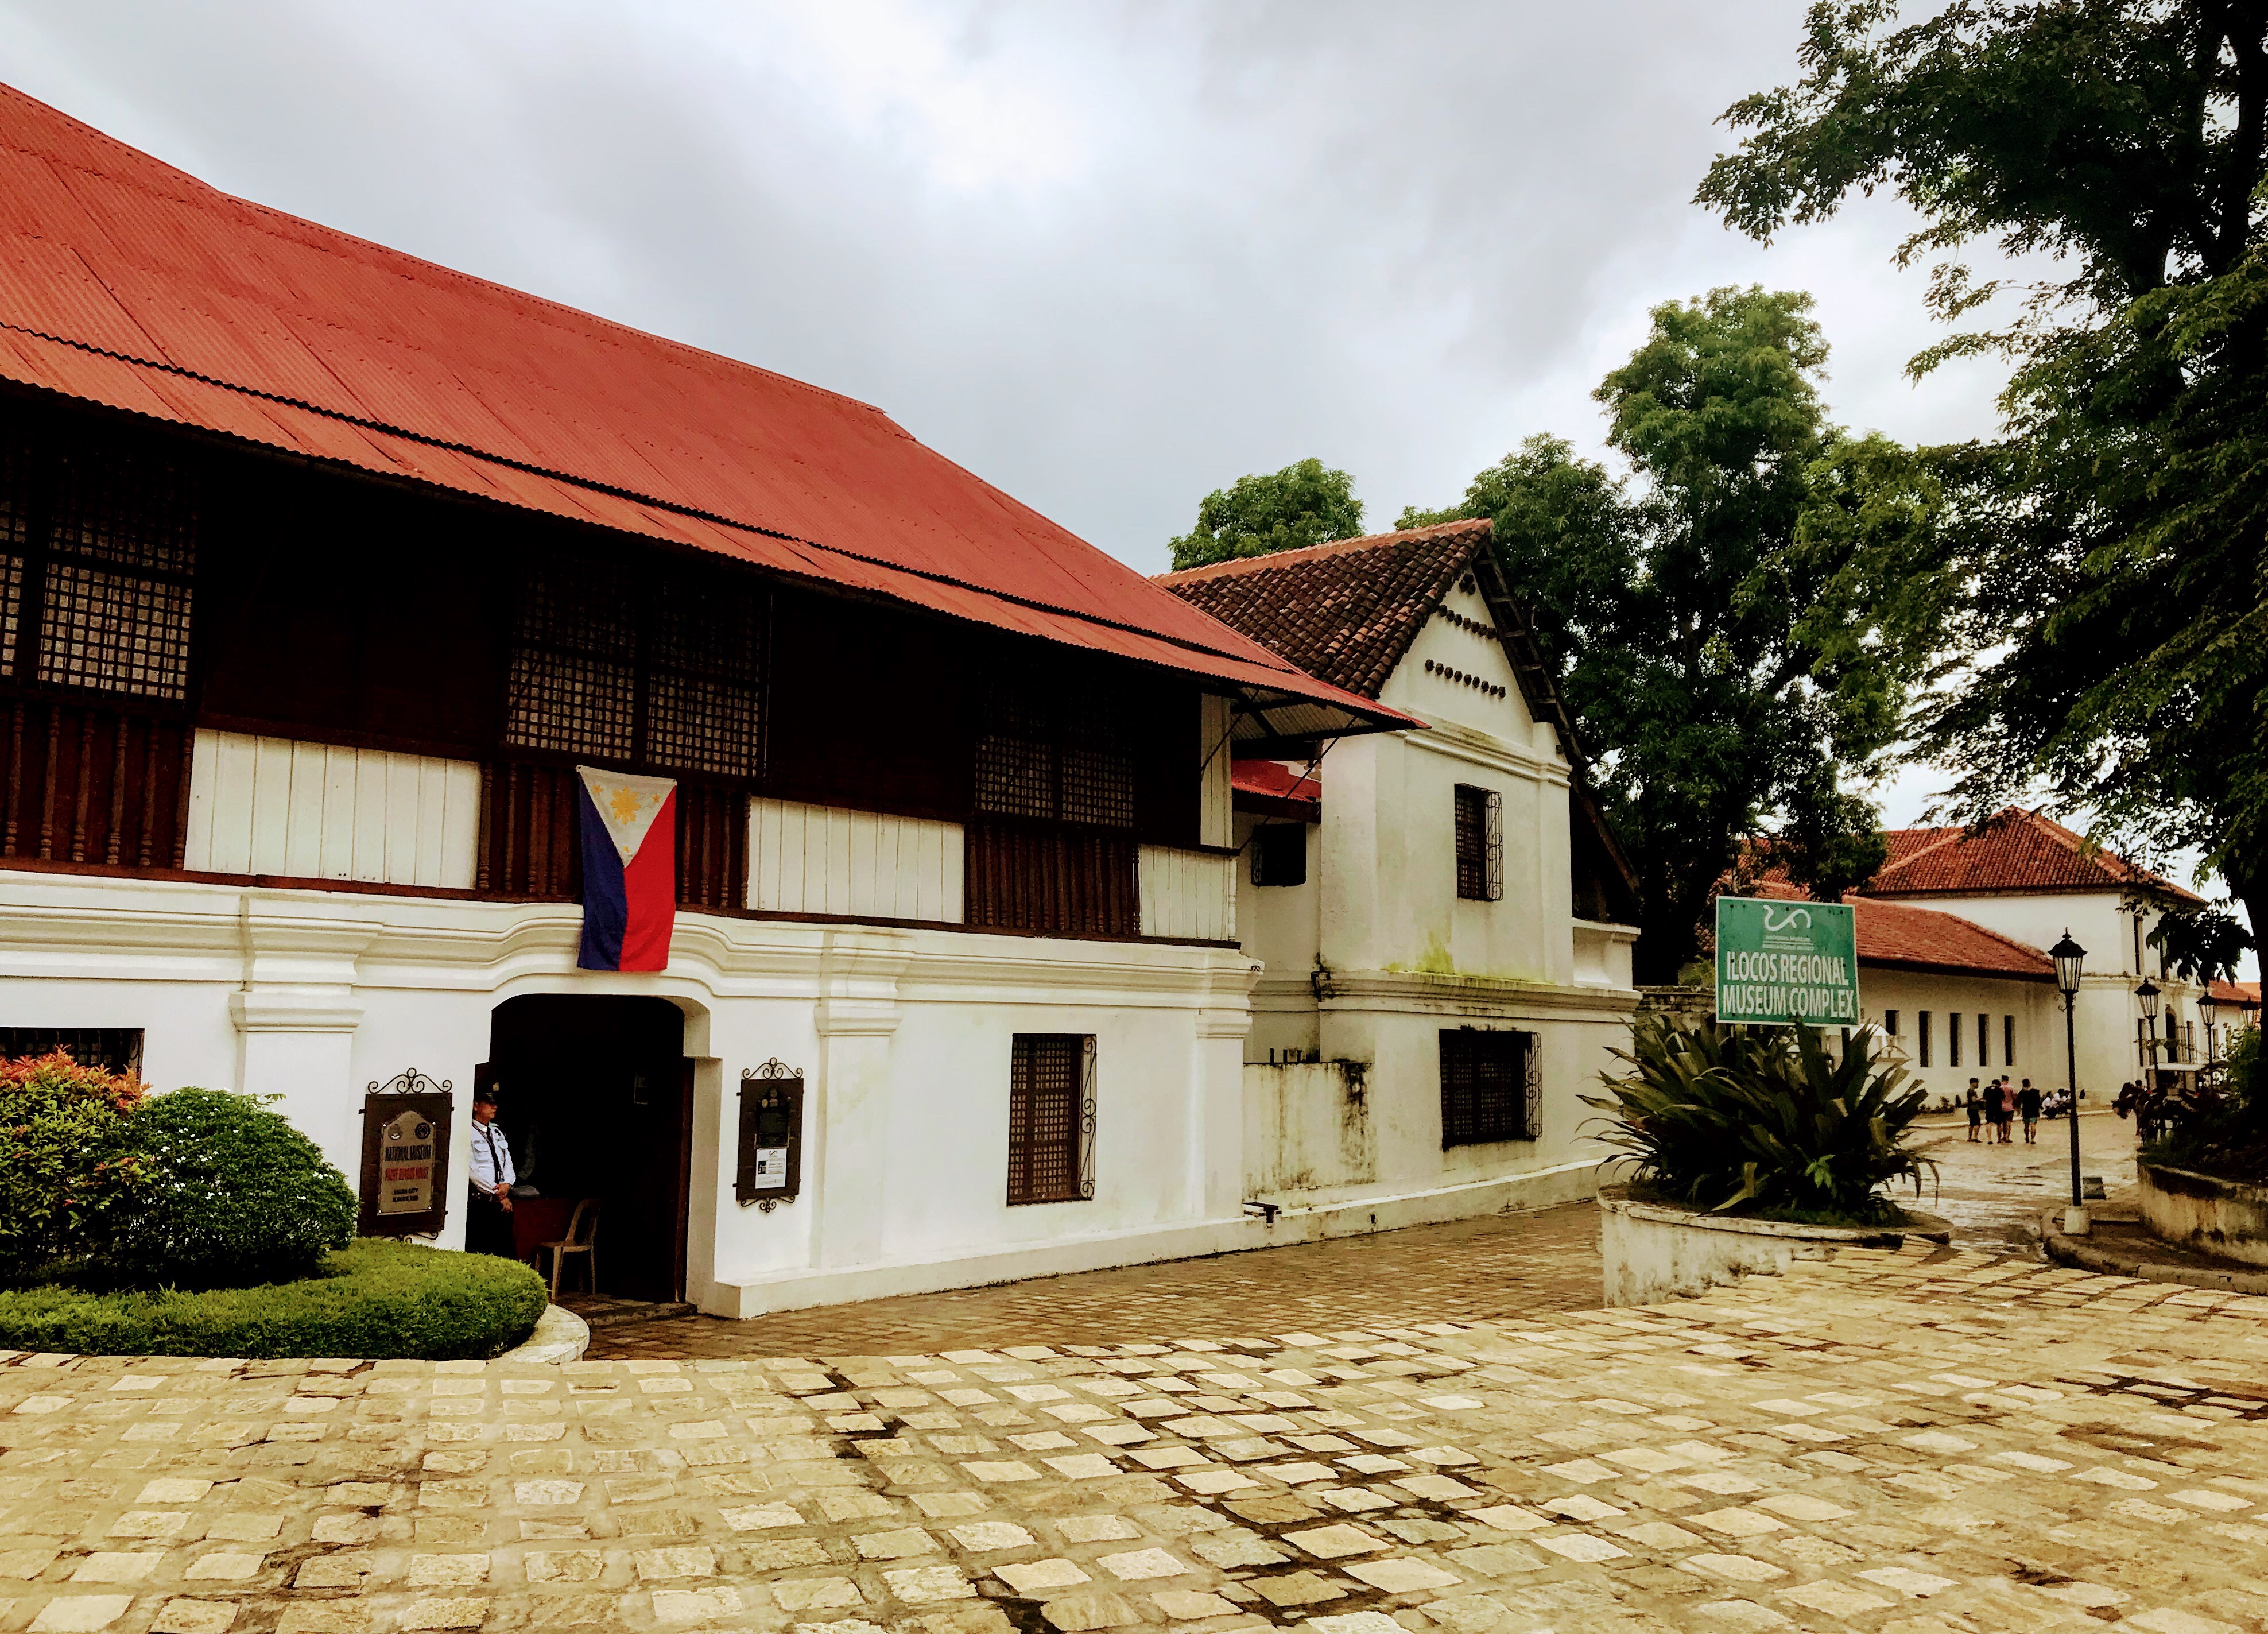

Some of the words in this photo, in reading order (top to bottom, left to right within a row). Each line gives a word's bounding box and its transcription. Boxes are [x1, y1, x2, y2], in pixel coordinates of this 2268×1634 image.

[1727, 951, 1777, 982] ILOCOS
[1781, 953, 1849, 986] REGIONAL
[1723, 984, 1786, 1016] MUSEUM
[1789, 987, 1855, 1019] COMPLEX
[385, 1146, 409, 1161] NATIONAL
[410, 1145, 431, 1160] MUSEUM
